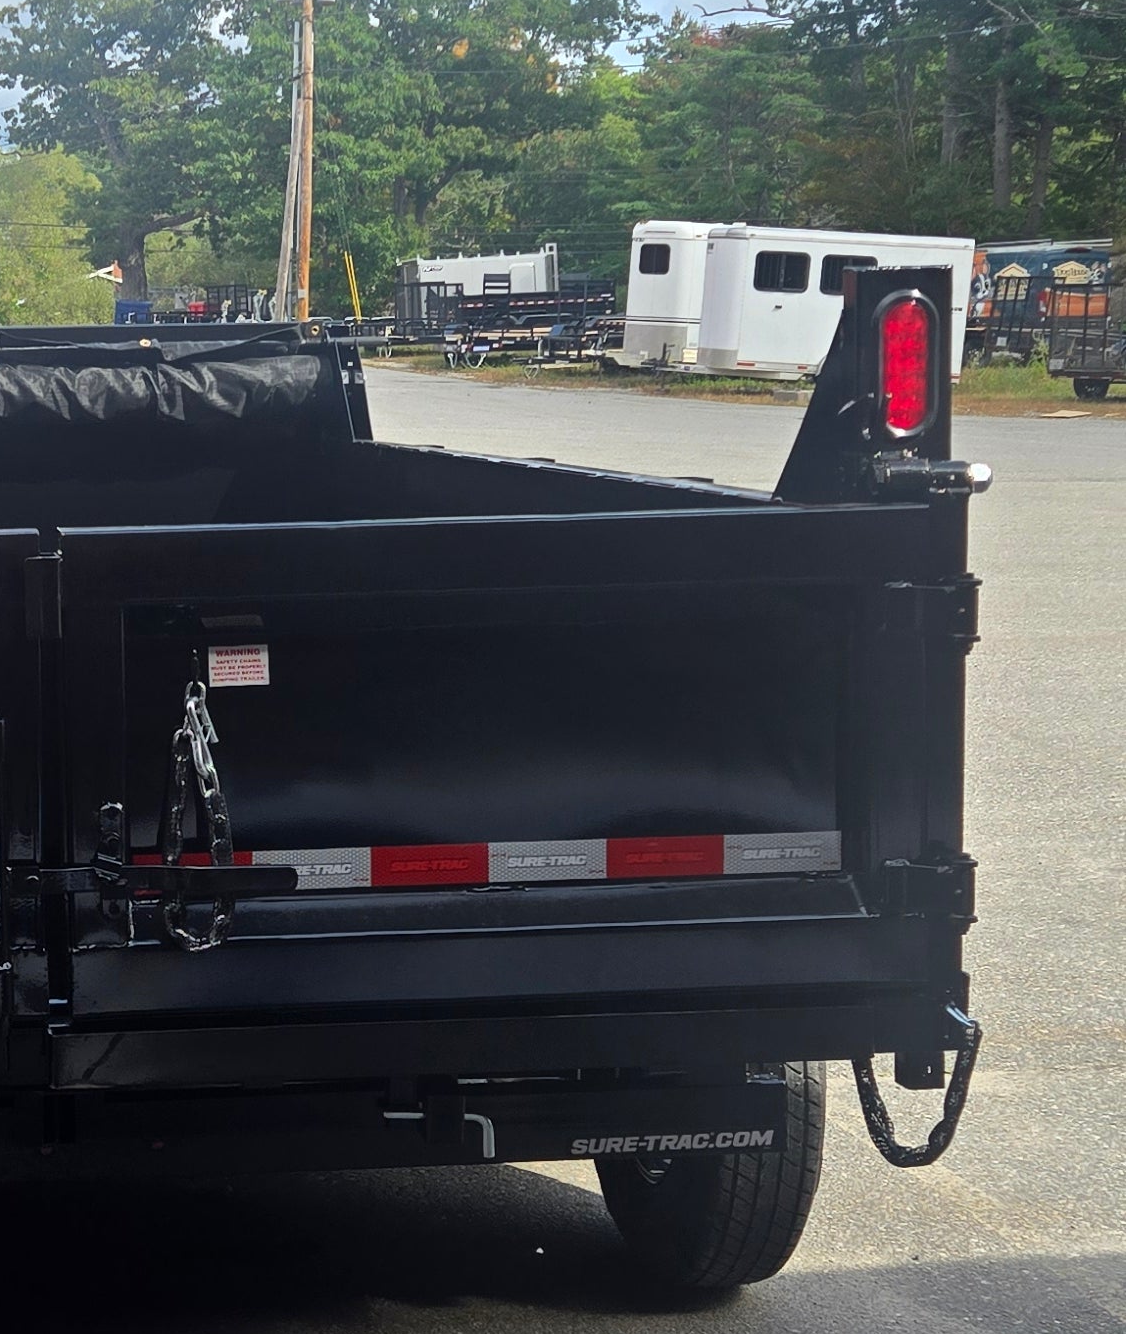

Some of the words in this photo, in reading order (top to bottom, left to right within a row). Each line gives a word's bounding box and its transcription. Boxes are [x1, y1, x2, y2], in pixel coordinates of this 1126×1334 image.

[215, 648, 261, 657] WARNING
[292, 863, 352, 876] RE-TRAC
[508, 855, 587, 868] SURE-TRAC
[743, 848, 820, 860] SURE-TRAC
[571, 1129, 775, 1155] SURE-TRAC.COM
